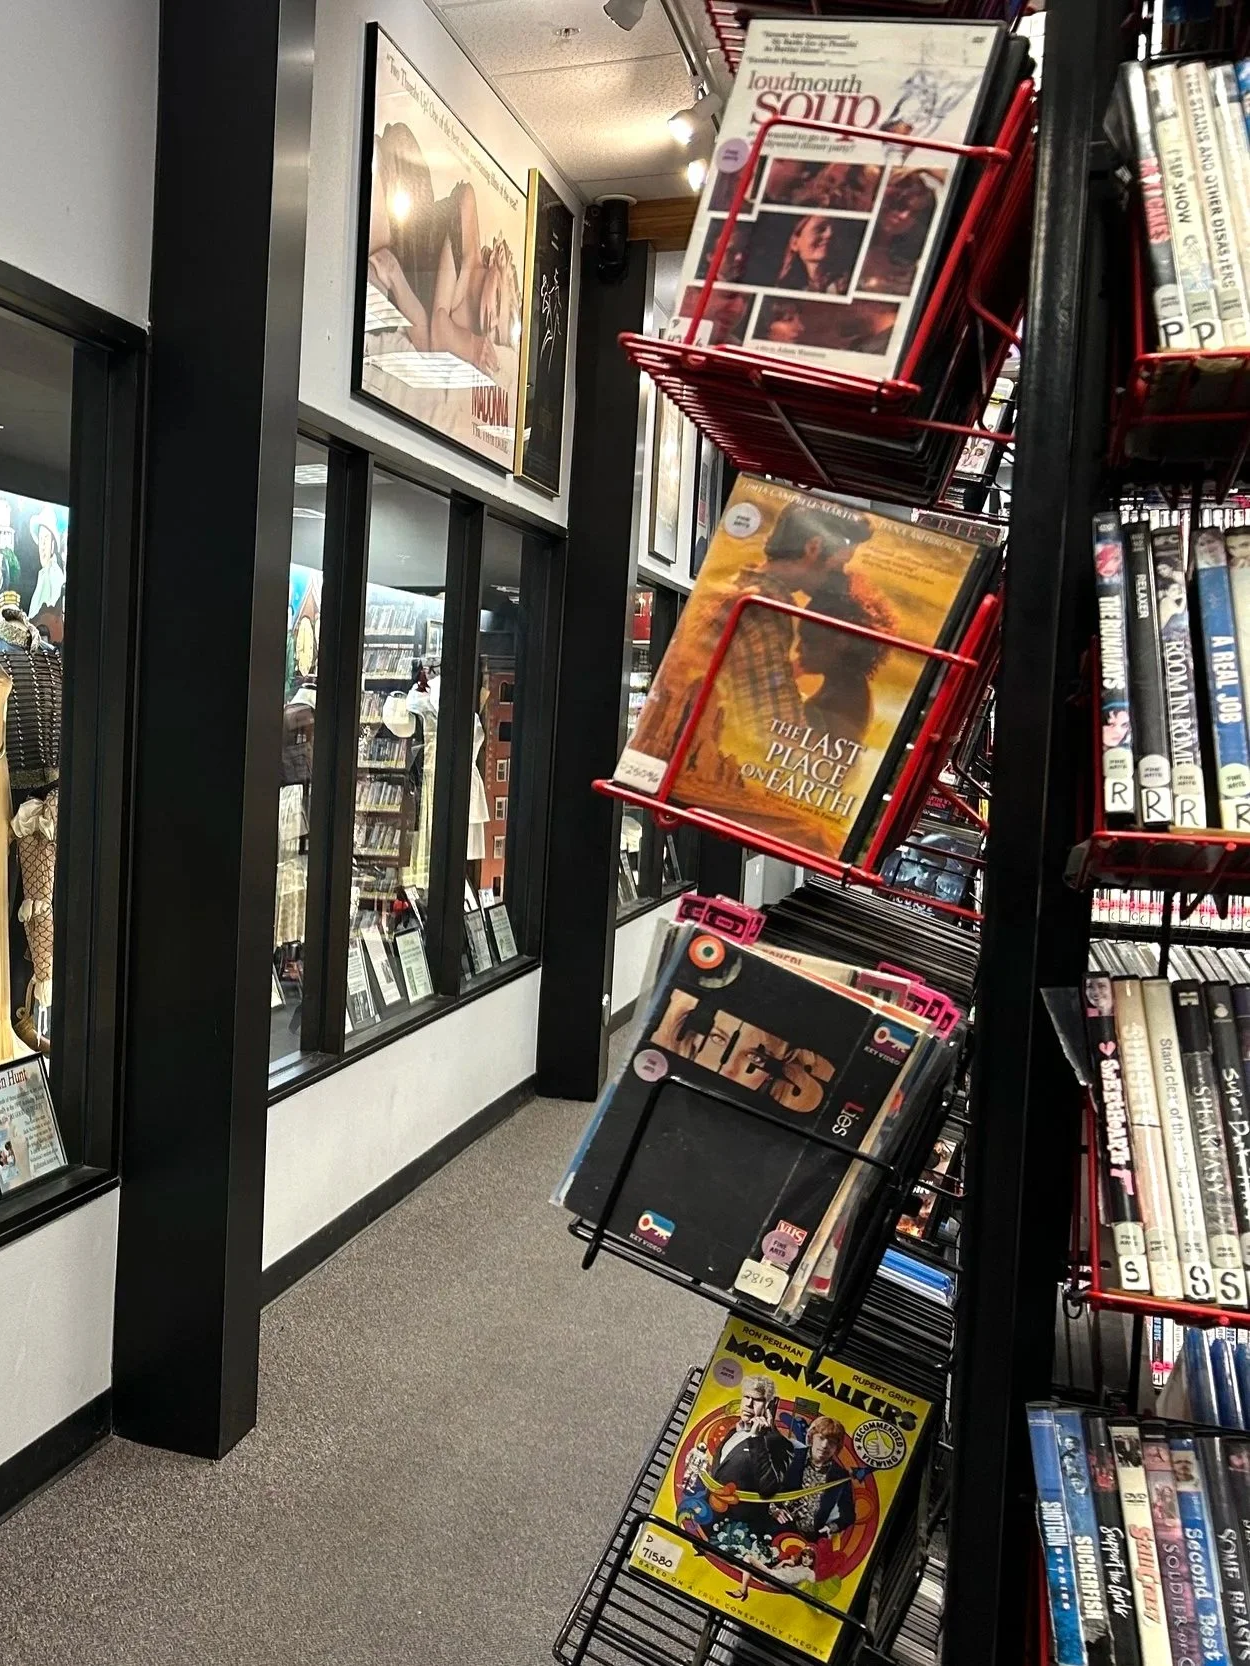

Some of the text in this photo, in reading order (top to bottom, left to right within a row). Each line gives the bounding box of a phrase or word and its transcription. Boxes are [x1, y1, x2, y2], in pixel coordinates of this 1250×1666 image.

[748, 70, 862, 93] loudmouth
[1161, 321, 1183, 347] P
[1192, 322, 1215, 349] P
[1135, 574, 1150, 618] RELAXER
[1098, 596, 1126, 690] THE RUNAWAYS
[1210, 635, 1241, 723] A REAL JOB
[1164, 641, 1193, 766] ROOM IN ROME
[770, 719, 866, 767] THE LAST
[765, 741, 852, 788] PLACE
[740, 763, 766, 782] ON
[765, 766, 856, 818] EARTH
[1112, 782, 1128, 804] R
[1146, 790, 1166, 819] R
[1180, 799, 1200, 826] R
[1236, 803, 1250, 828] R
[650, 988, 836, 1113] LIES
[864, 1045, 902, 1067] KEY VIDEO
[7, 1068, 28, 1087] Hunt
[1159, 1039, 1176, 1073] Stand
[1168, 1108, 1184, 1121] of
[1222, 1067, 1242, 1116] Super
[1191, 1086, 1225, 1196] SPEAKEASY
[629, 1233, 664, 1254] KEY VIDEO
[773, 1239, 787, 1251] FINE
[779, 1221, 806, 1244] VHS
[769, 1246, 786, 1258] ARTS
[740, 1269, 774, 1288] 2819
[1125, 1261, 1139, 1283] S
[1190, 1265, 1209, 1296] S
[1220, 1272, 1241, 1301] S
[742, 1326, 804, 1358] RON PERLMAN
[724, 1333, 919, 1431] MOONWALKERS
[852, 1374, 916, 1407] RUPERT GRINT
[855, 1421, 904, 1448] RECOMMENDED
[862, 1453, 899, 1469] VIEWING
[646, 1535, 654, 1544] D
[642, 1546, 673, 1568] 71580
[1040, 1501, 1071, 1610] SHOTGUN STORIES
[1074, 1535, 1104, 1620] SUCKERFISH
[1099, 1525, 1132, 1618] Support the Girls
[1162, 1543, 1188, 1627] SOLDIER
[639, 1560, 826, 1656] BASED ON A TRUE CONSPIRACY THEORY
[1185, 1527, 1223, 1661] Second Best
[1217, 1527, 1250, 1661] SOME BEASTS
